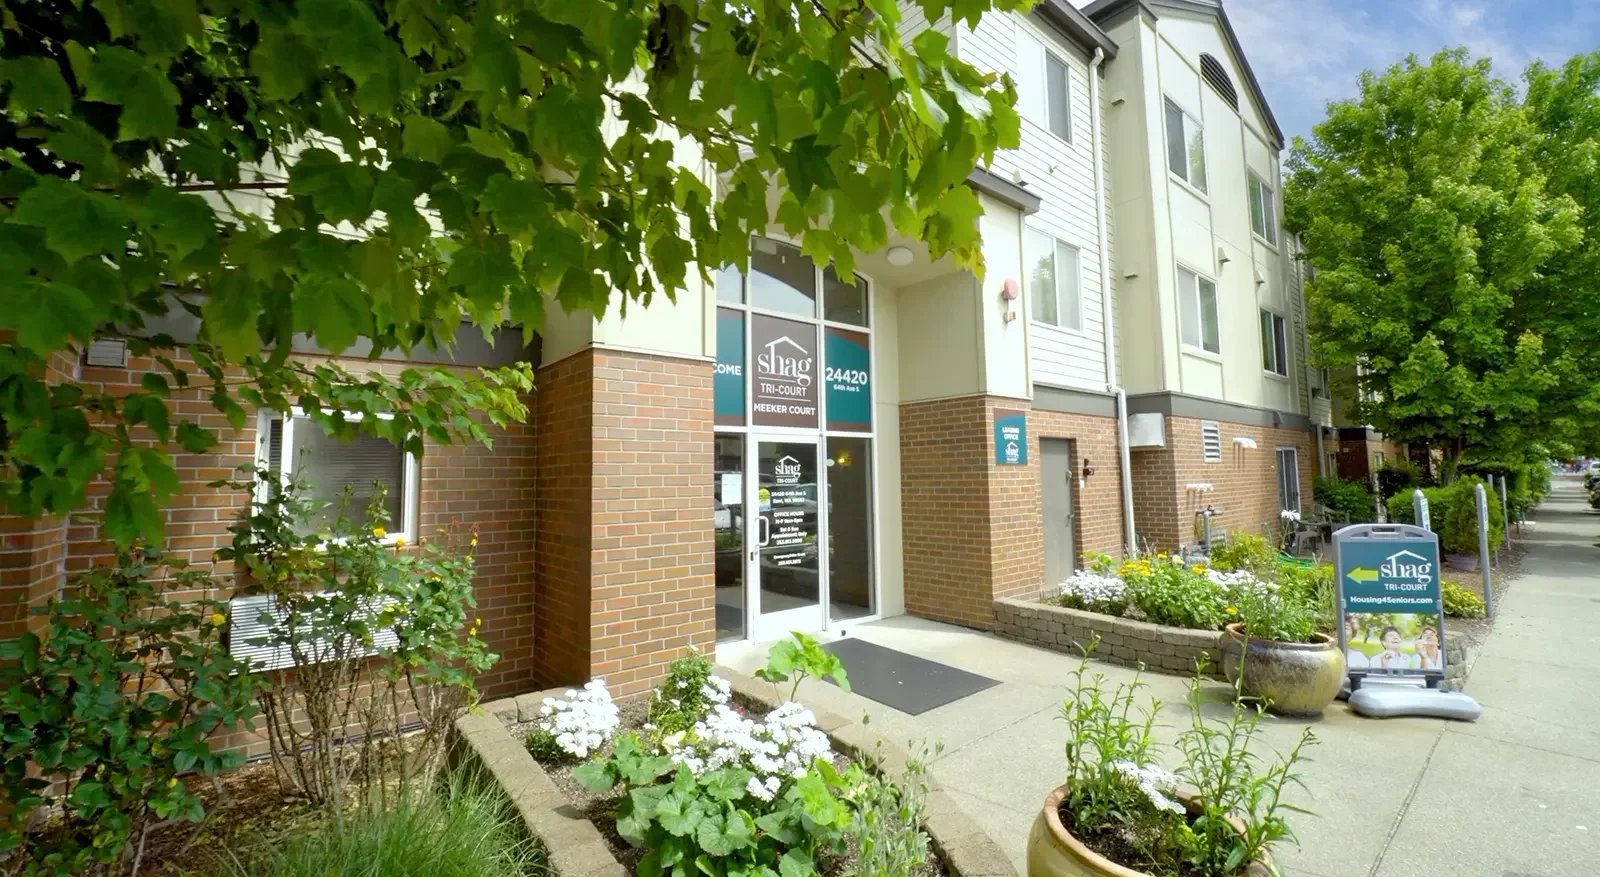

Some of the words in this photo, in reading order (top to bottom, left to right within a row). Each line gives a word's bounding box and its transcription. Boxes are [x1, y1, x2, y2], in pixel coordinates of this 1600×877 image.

[758, 342, 812, 387] shag
[825, 367, 868, 385] 24420
[760, 383, 807, 397] TRI-COURT
[754, 404, 787, 414] MEEKER
[789, 405, 816, 416] COURT
[775, 460, 801, 478] shag
[1381, 556, 1432, 584] shag
[1384, 583, 1428, 591] TRI-COURT
[1350, 595, 1433, 604] Housing4Seniors.com
